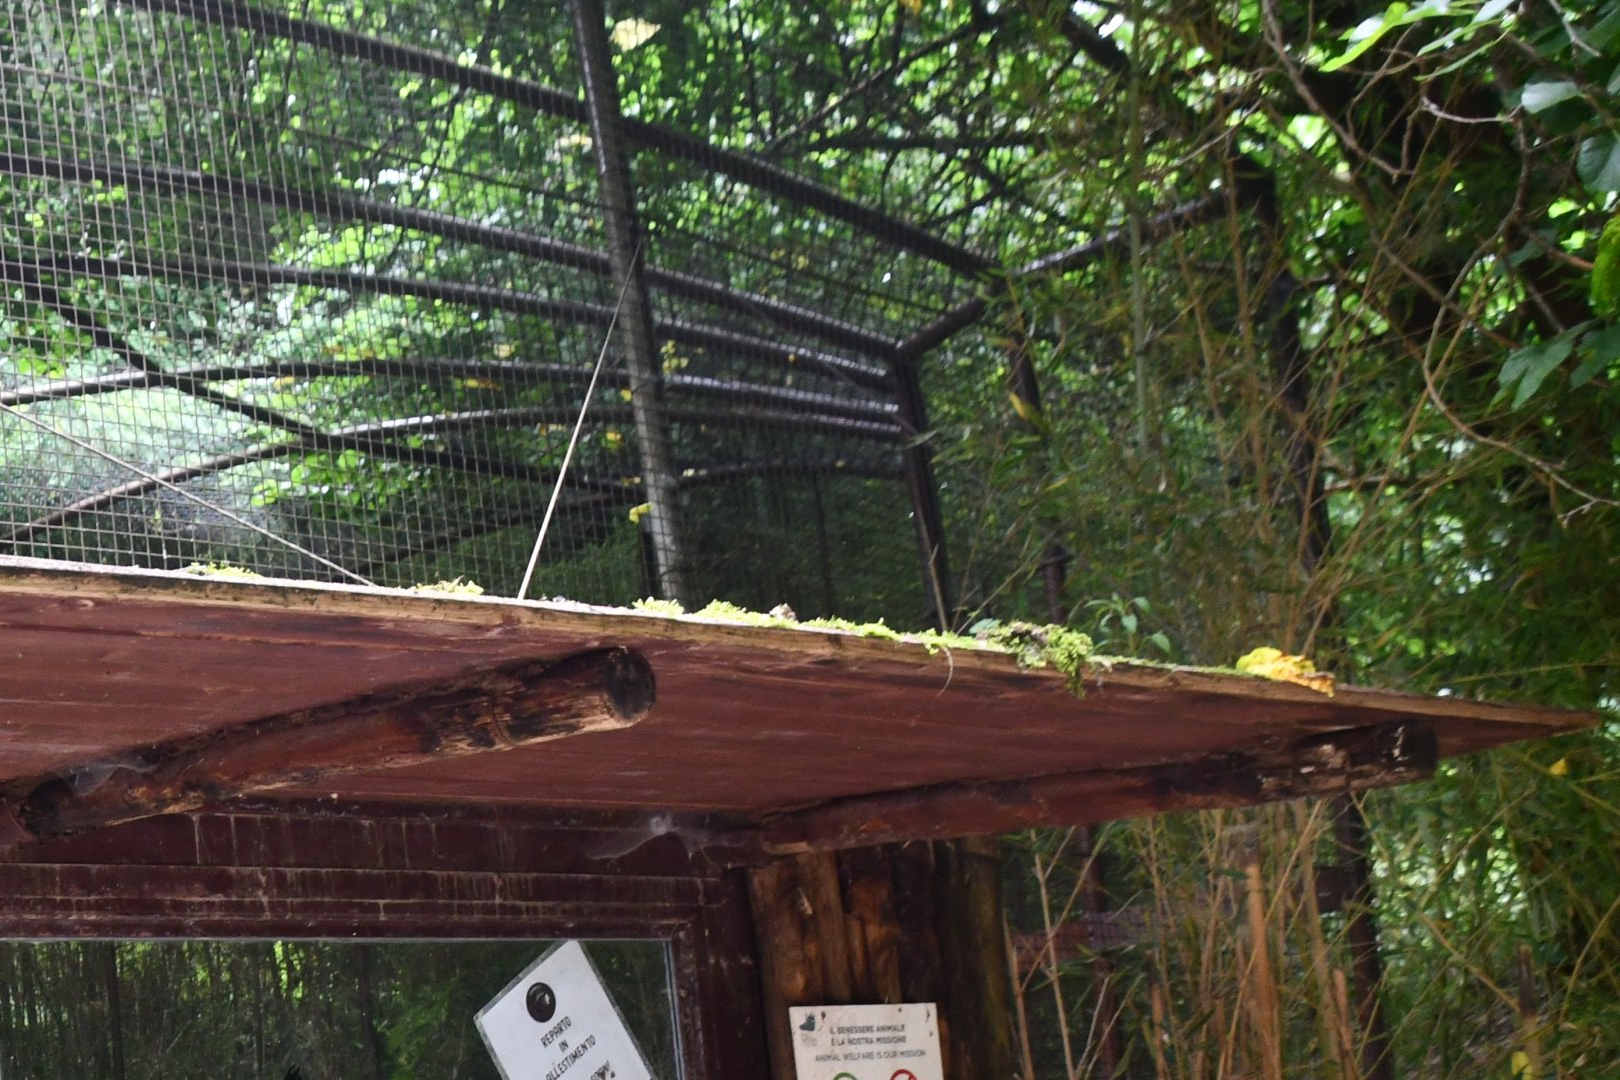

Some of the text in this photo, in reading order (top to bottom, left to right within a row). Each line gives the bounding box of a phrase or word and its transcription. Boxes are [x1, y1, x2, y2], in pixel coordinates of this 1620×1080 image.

[540, 1016, 571, 1048] REPARTO
[837, 1025, 874, 1034] BENESSERE
[876, 1023, 905, 1033] ANIMALE
[558, 1039, 569, 1053] IN
[837, 1037, 845, 1046] LA
[847, 1036, 874, 1045] NOSTRA
[876, 1035, 906, 1044] MISSIONE
[815, 1053, 841, 1062] ANIMAL
[843, 1051, 874, 1060] WELFARE
[881, 1050, 897, 1059] OUR
[899, 1049, 926, 1058] MISSION
